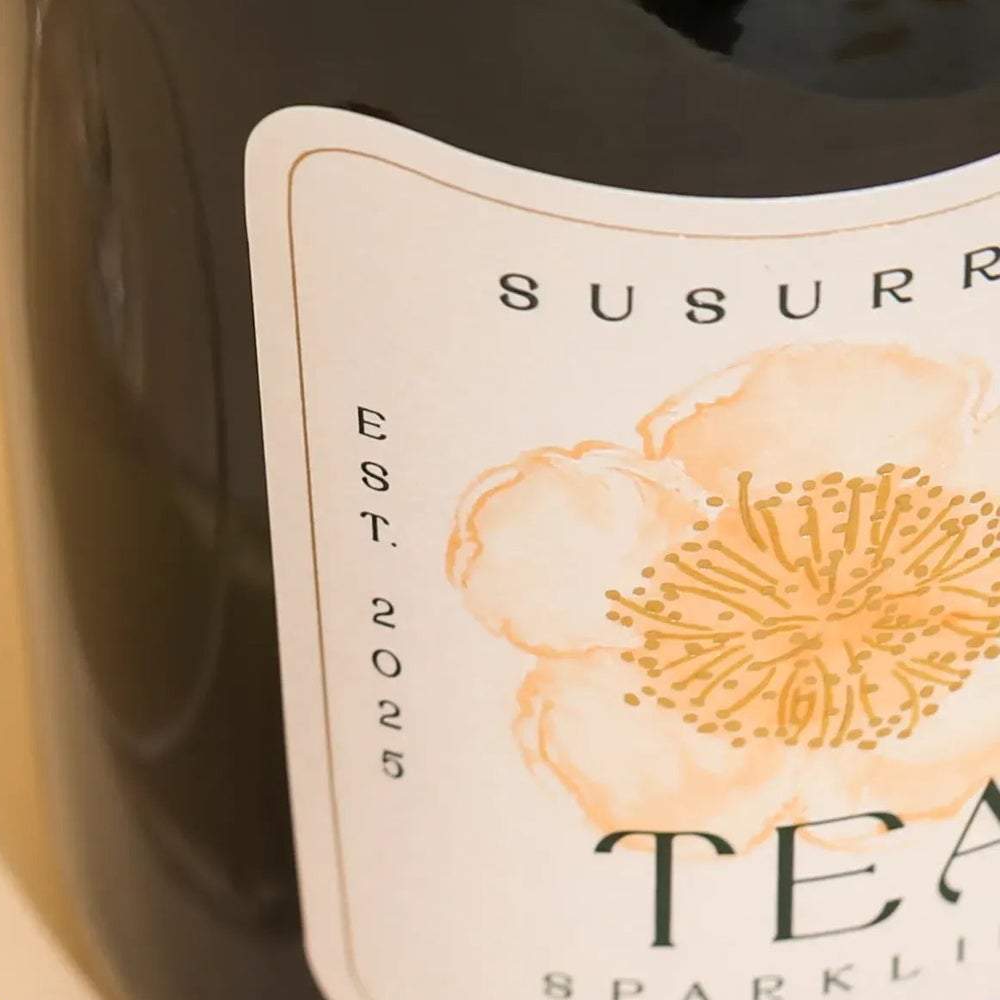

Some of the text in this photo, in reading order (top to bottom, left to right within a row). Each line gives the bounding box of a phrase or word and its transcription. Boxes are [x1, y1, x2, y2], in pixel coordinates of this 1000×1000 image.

[356, 406, 404, 779] EST. 2025
[594, 777, 1000, 948] TEA
